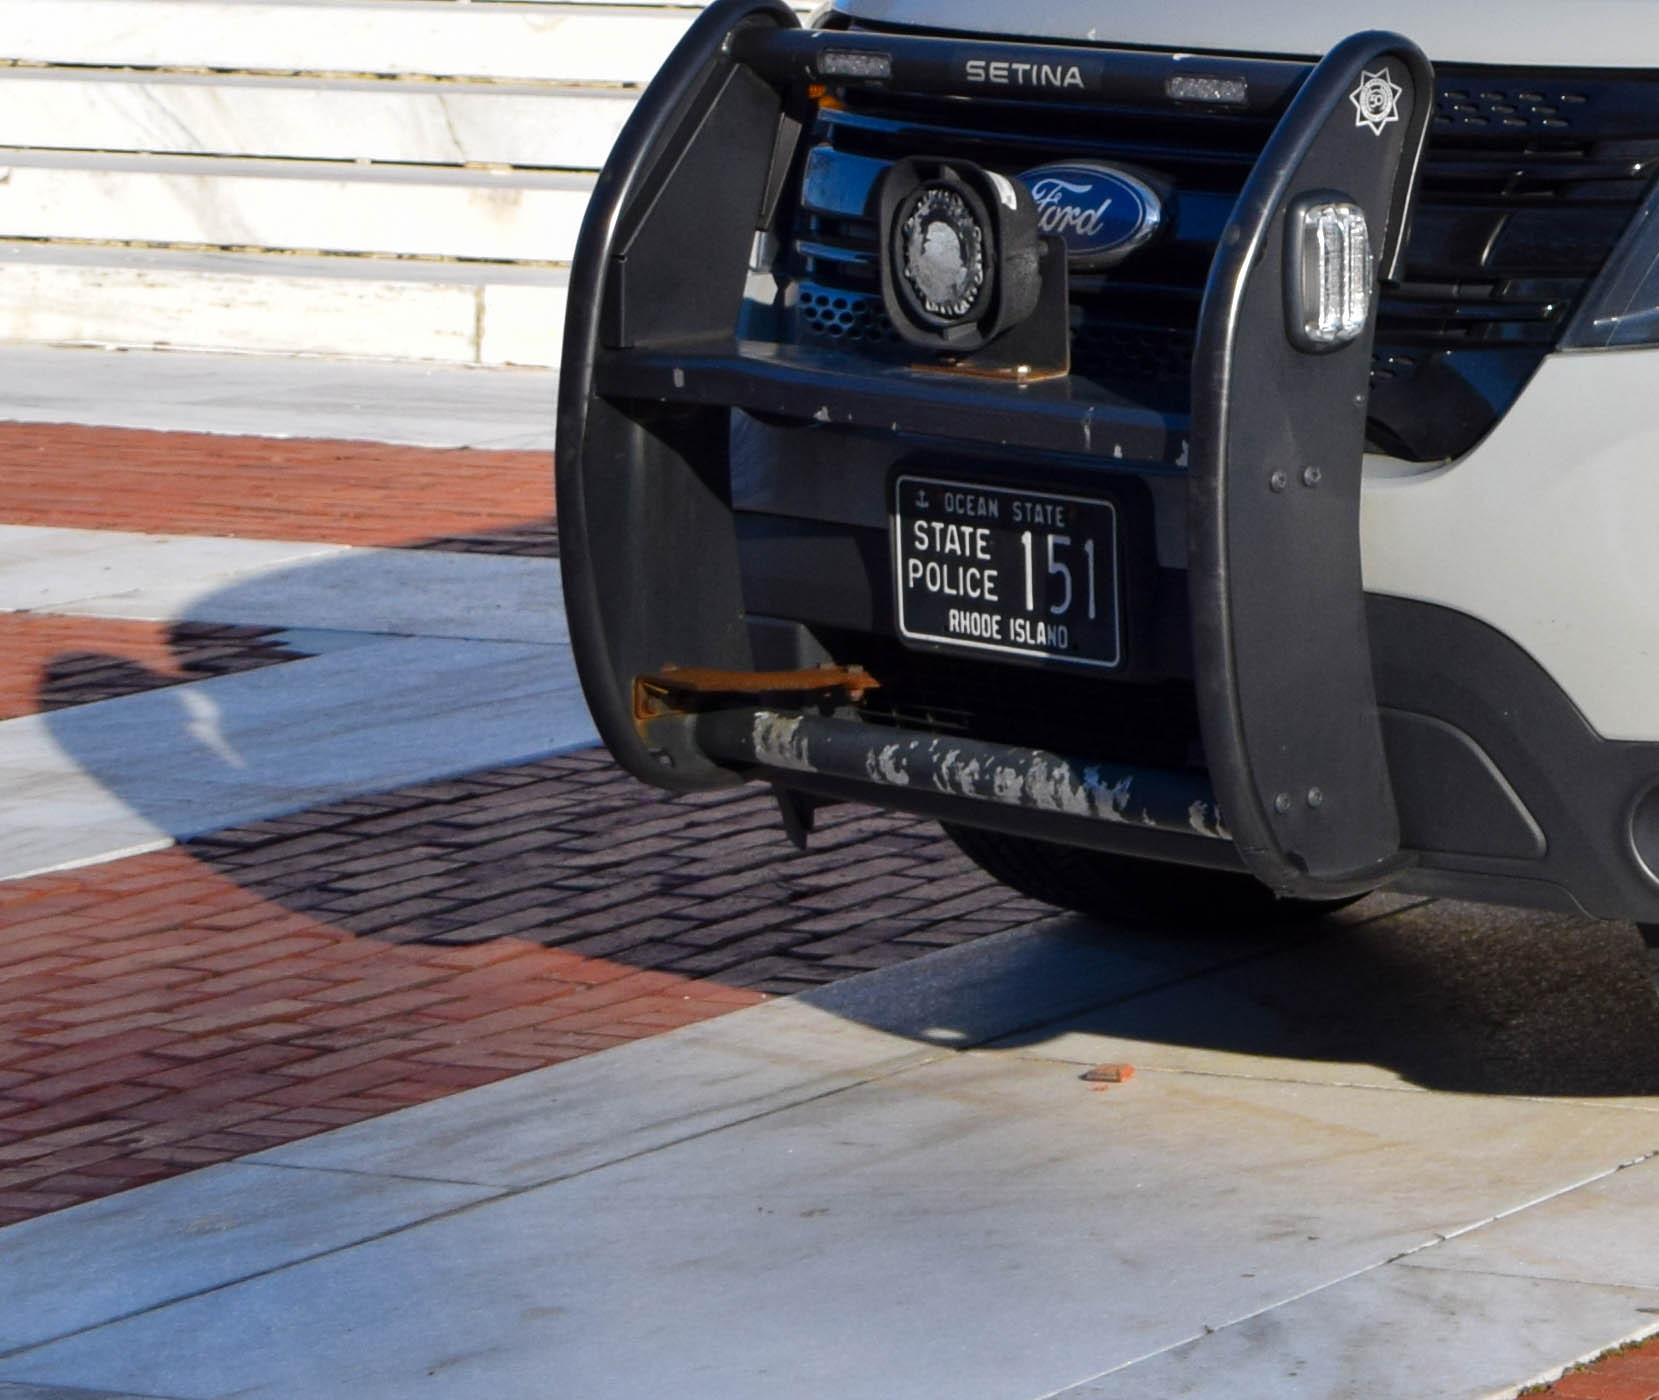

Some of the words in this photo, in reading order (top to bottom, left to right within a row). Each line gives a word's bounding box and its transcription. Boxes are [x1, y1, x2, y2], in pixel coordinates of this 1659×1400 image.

[966, 60, 1084, 88] SETINA
[1031, 178, 1112, 236] Ford
[944, 492, 999, 518] OCEAN
[1012, 502, 1065, 528] STATE
[913, 520, 991, 560] STATE
[908, 558, 999, 602] POLICE
[1021, 530, 1096, 619] 151
[949, 608, 1002, 640] RHODE
[1009, 617, 1069, 649] ISLAND
